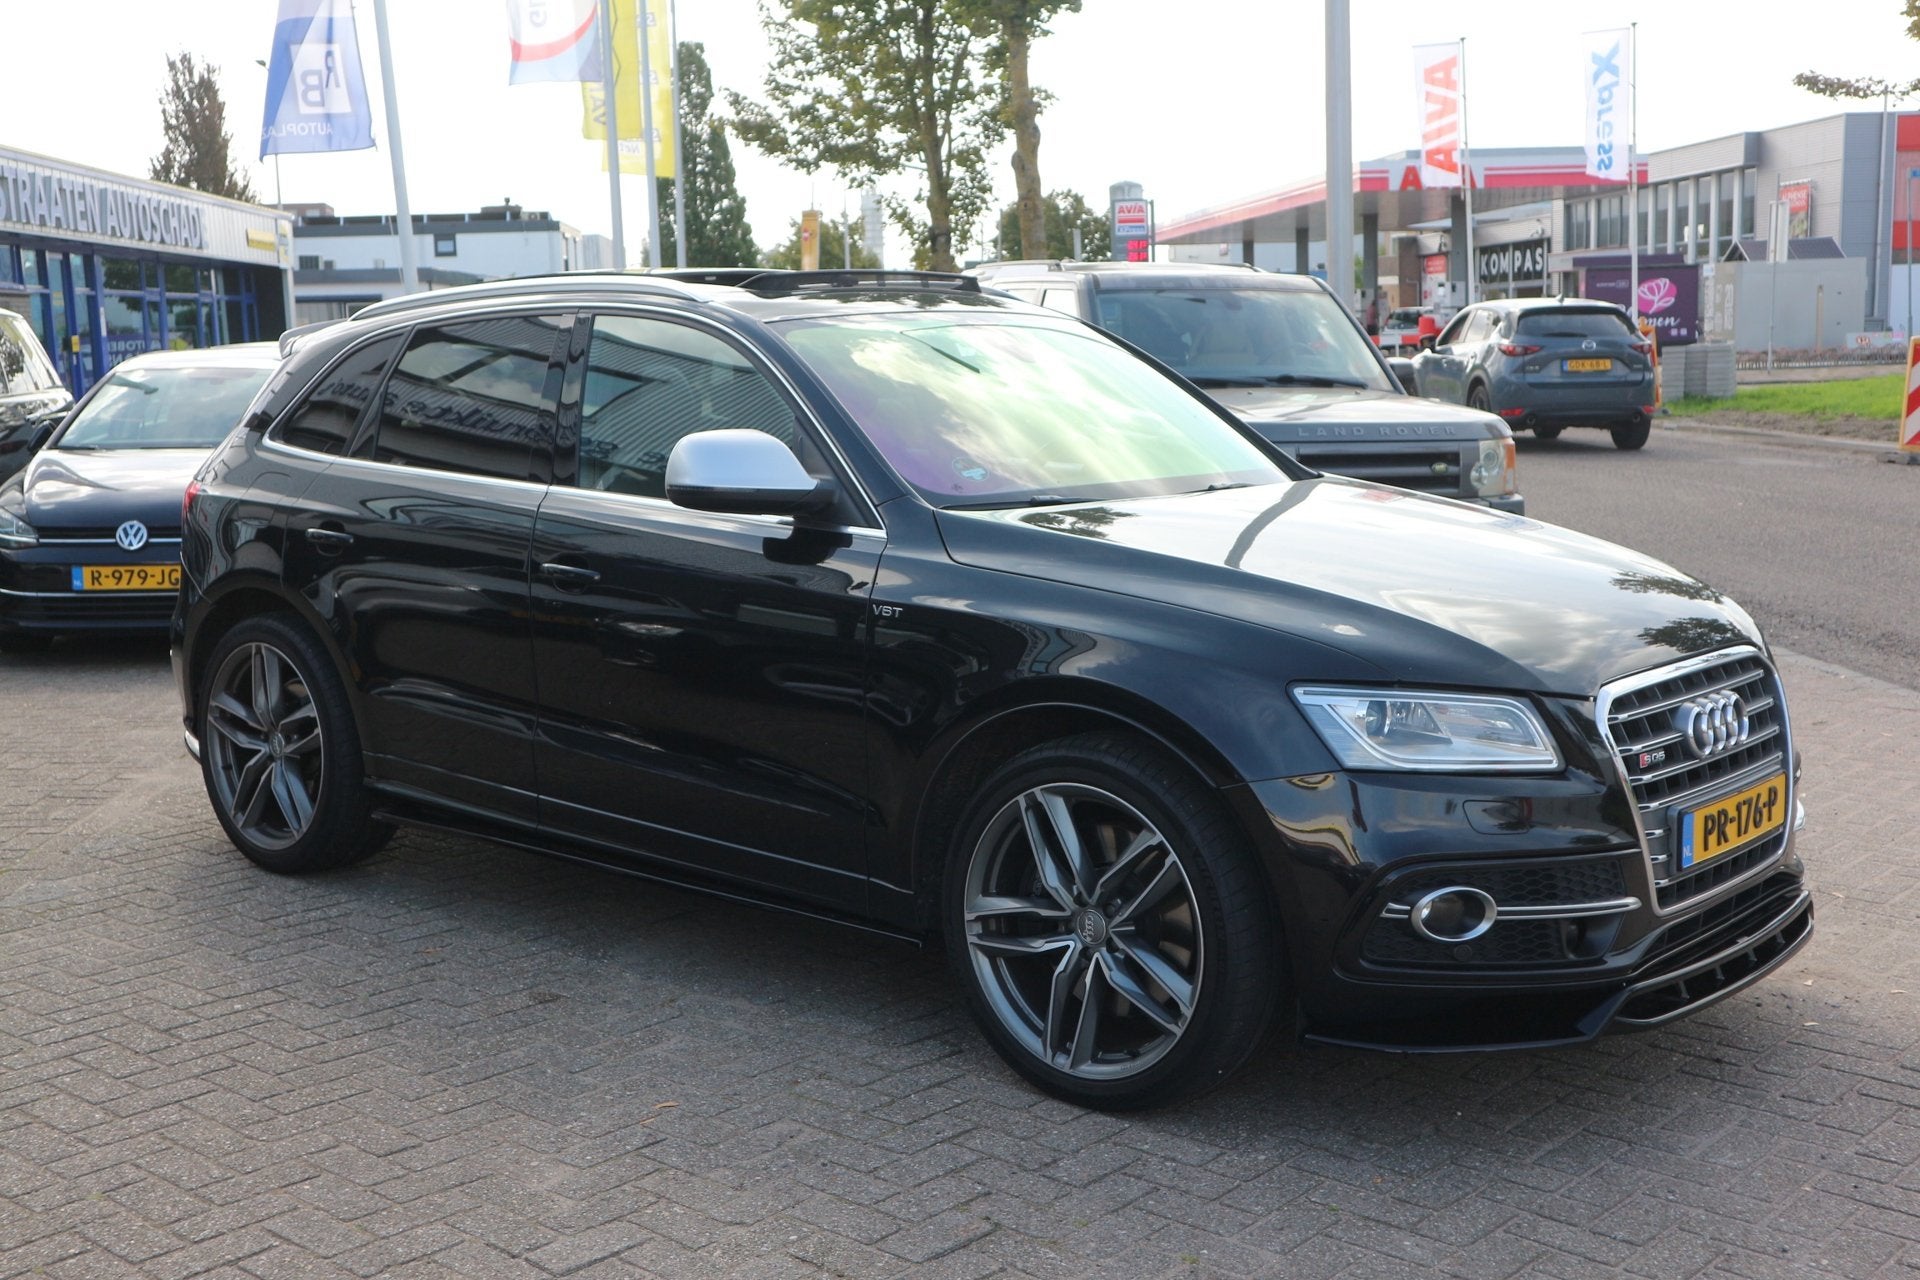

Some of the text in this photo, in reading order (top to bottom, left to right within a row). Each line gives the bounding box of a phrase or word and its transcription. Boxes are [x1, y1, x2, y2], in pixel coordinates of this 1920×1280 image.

[1118, 203, 1145, 214] AVIA
[1298, 426, 1457, 437] LAND ROVER
[91, 568, 179, 587] R-979-JG
[1703, 785, 1779, 852] PR-176-P
[1683, 844, 1693, 858] NL
